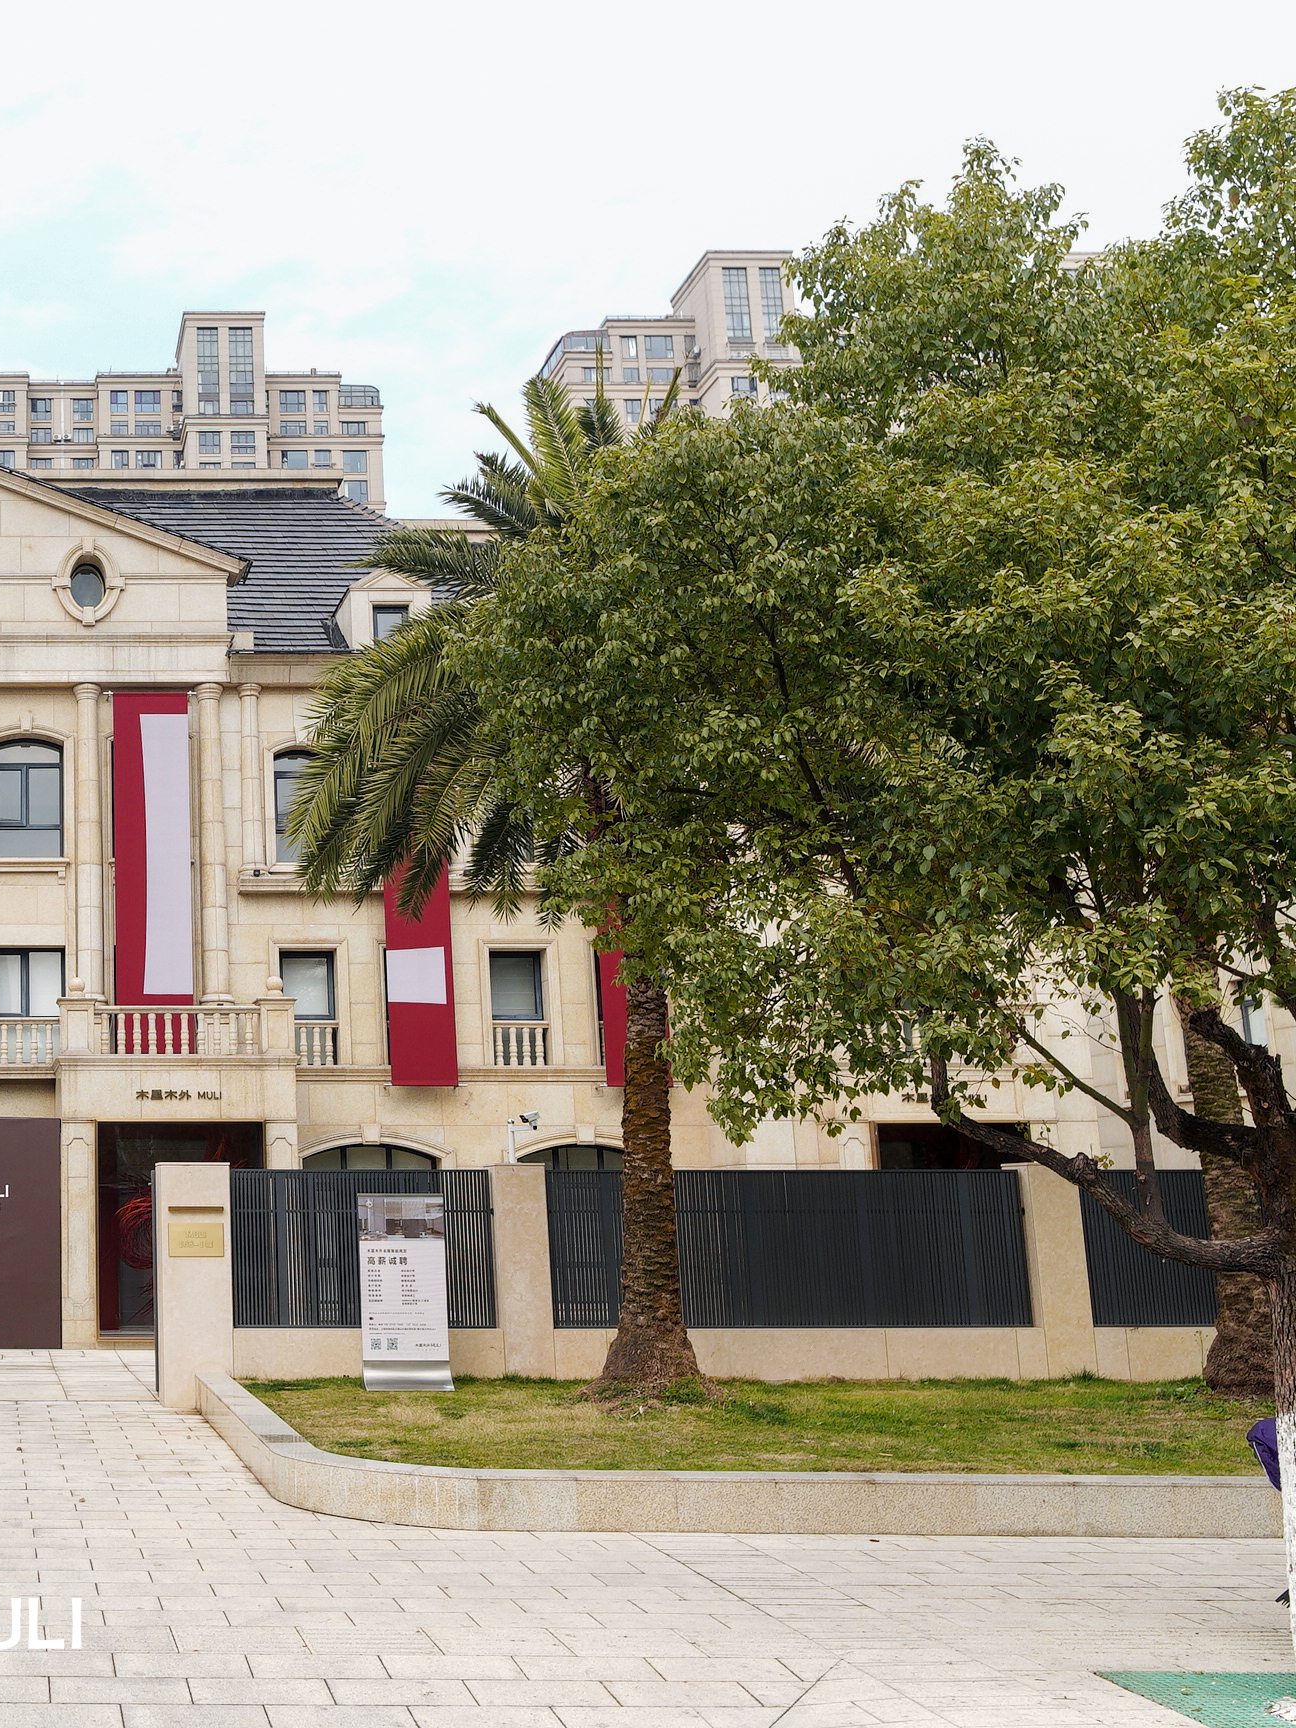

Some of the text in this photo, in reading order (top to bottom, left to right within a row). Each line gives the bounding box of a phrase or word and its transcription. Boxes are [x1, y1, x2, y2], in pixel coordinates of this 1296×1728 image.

[136, 1090, 222, 1101] 木里木外 MULI
[367, 1256, 408, 1266] 高薪诚聘
